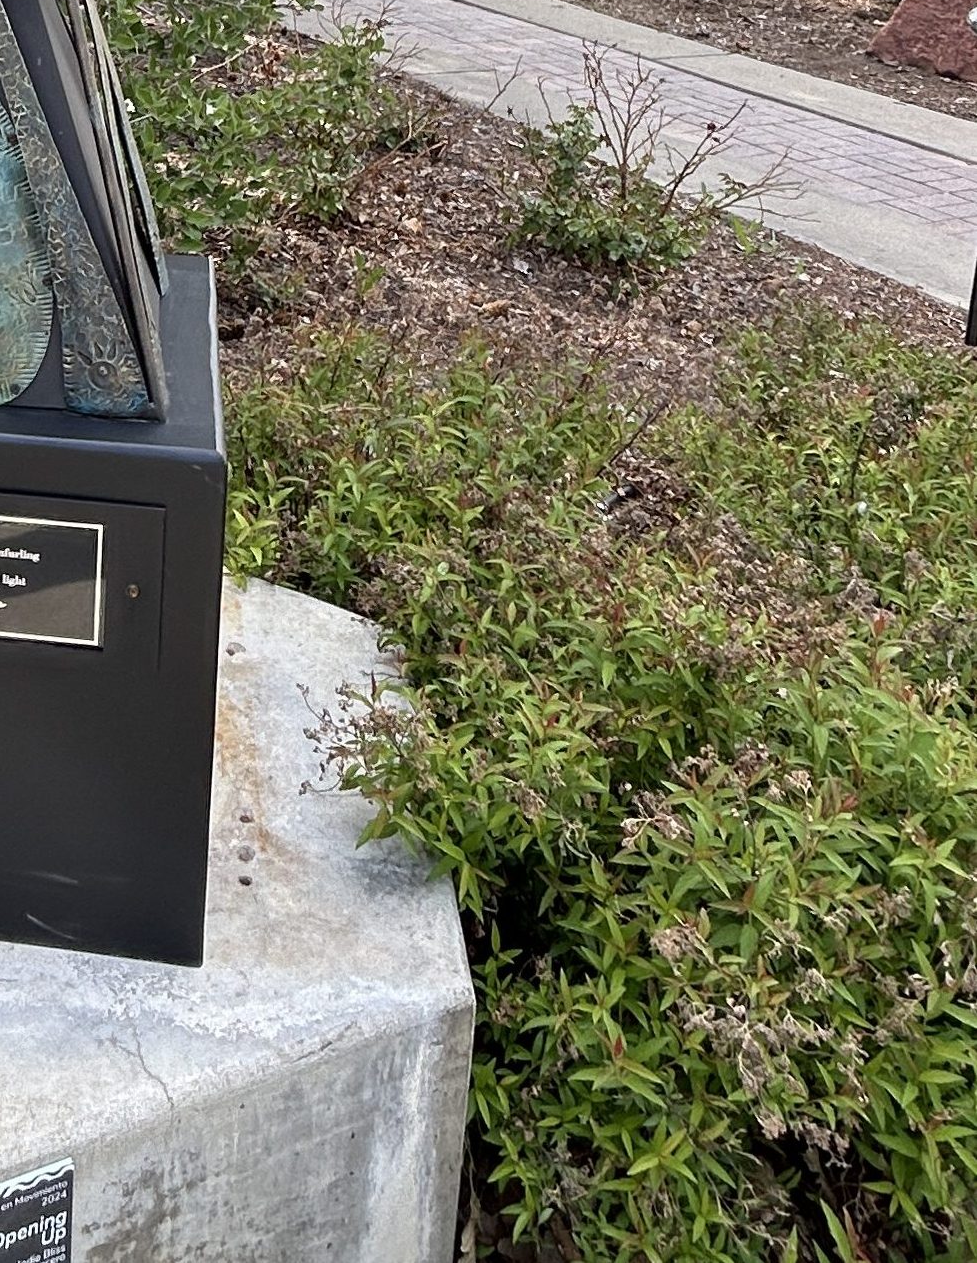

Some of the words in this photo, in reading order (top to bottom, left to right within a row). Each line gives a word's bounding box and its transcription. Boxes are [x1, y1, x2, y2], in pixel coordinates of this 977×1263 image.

[1, 573, 26, 587] light
[1, 1200, 13, 1211] en
[41, 1188, 67, 1207] 2024
[41, 1226, 67, 1247] Up
